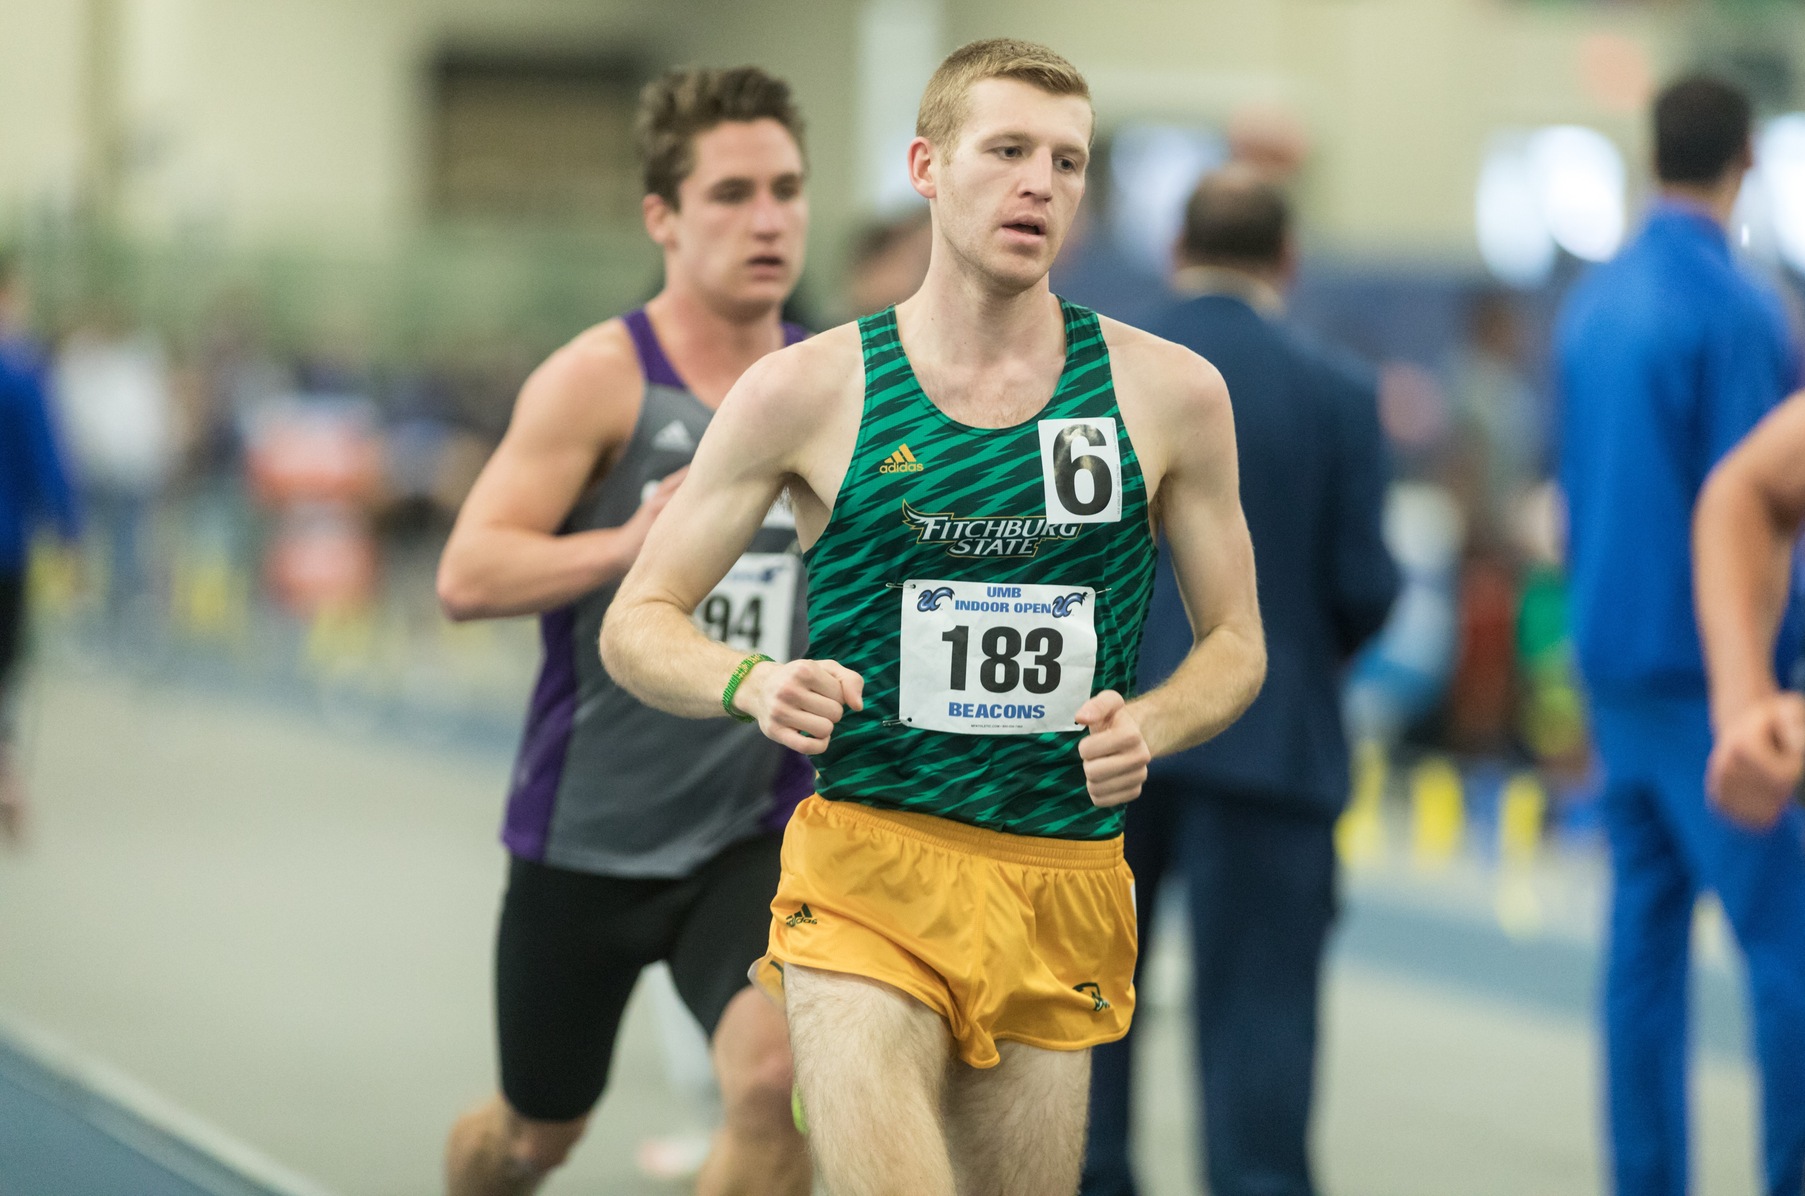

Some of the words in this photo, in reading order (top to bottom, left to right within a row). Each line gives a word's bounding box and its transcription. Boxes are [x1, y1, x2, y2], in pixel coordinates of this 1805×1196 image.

[879, 460, 924, 474] adidas
[1053, 424, 1113, 516] 6
[906, 510, 1078, 540] FITCHBURG
[949, 537, 1039, 555] STATE
[987, 586, 1022, 598] UMB
[954, 600, 1010, 613] INDOOR
[1014, 602, 1051, 614] OPEN
[942, 625, 1064, 694] 183
[948, 702, 1045, 719] BEACONS
